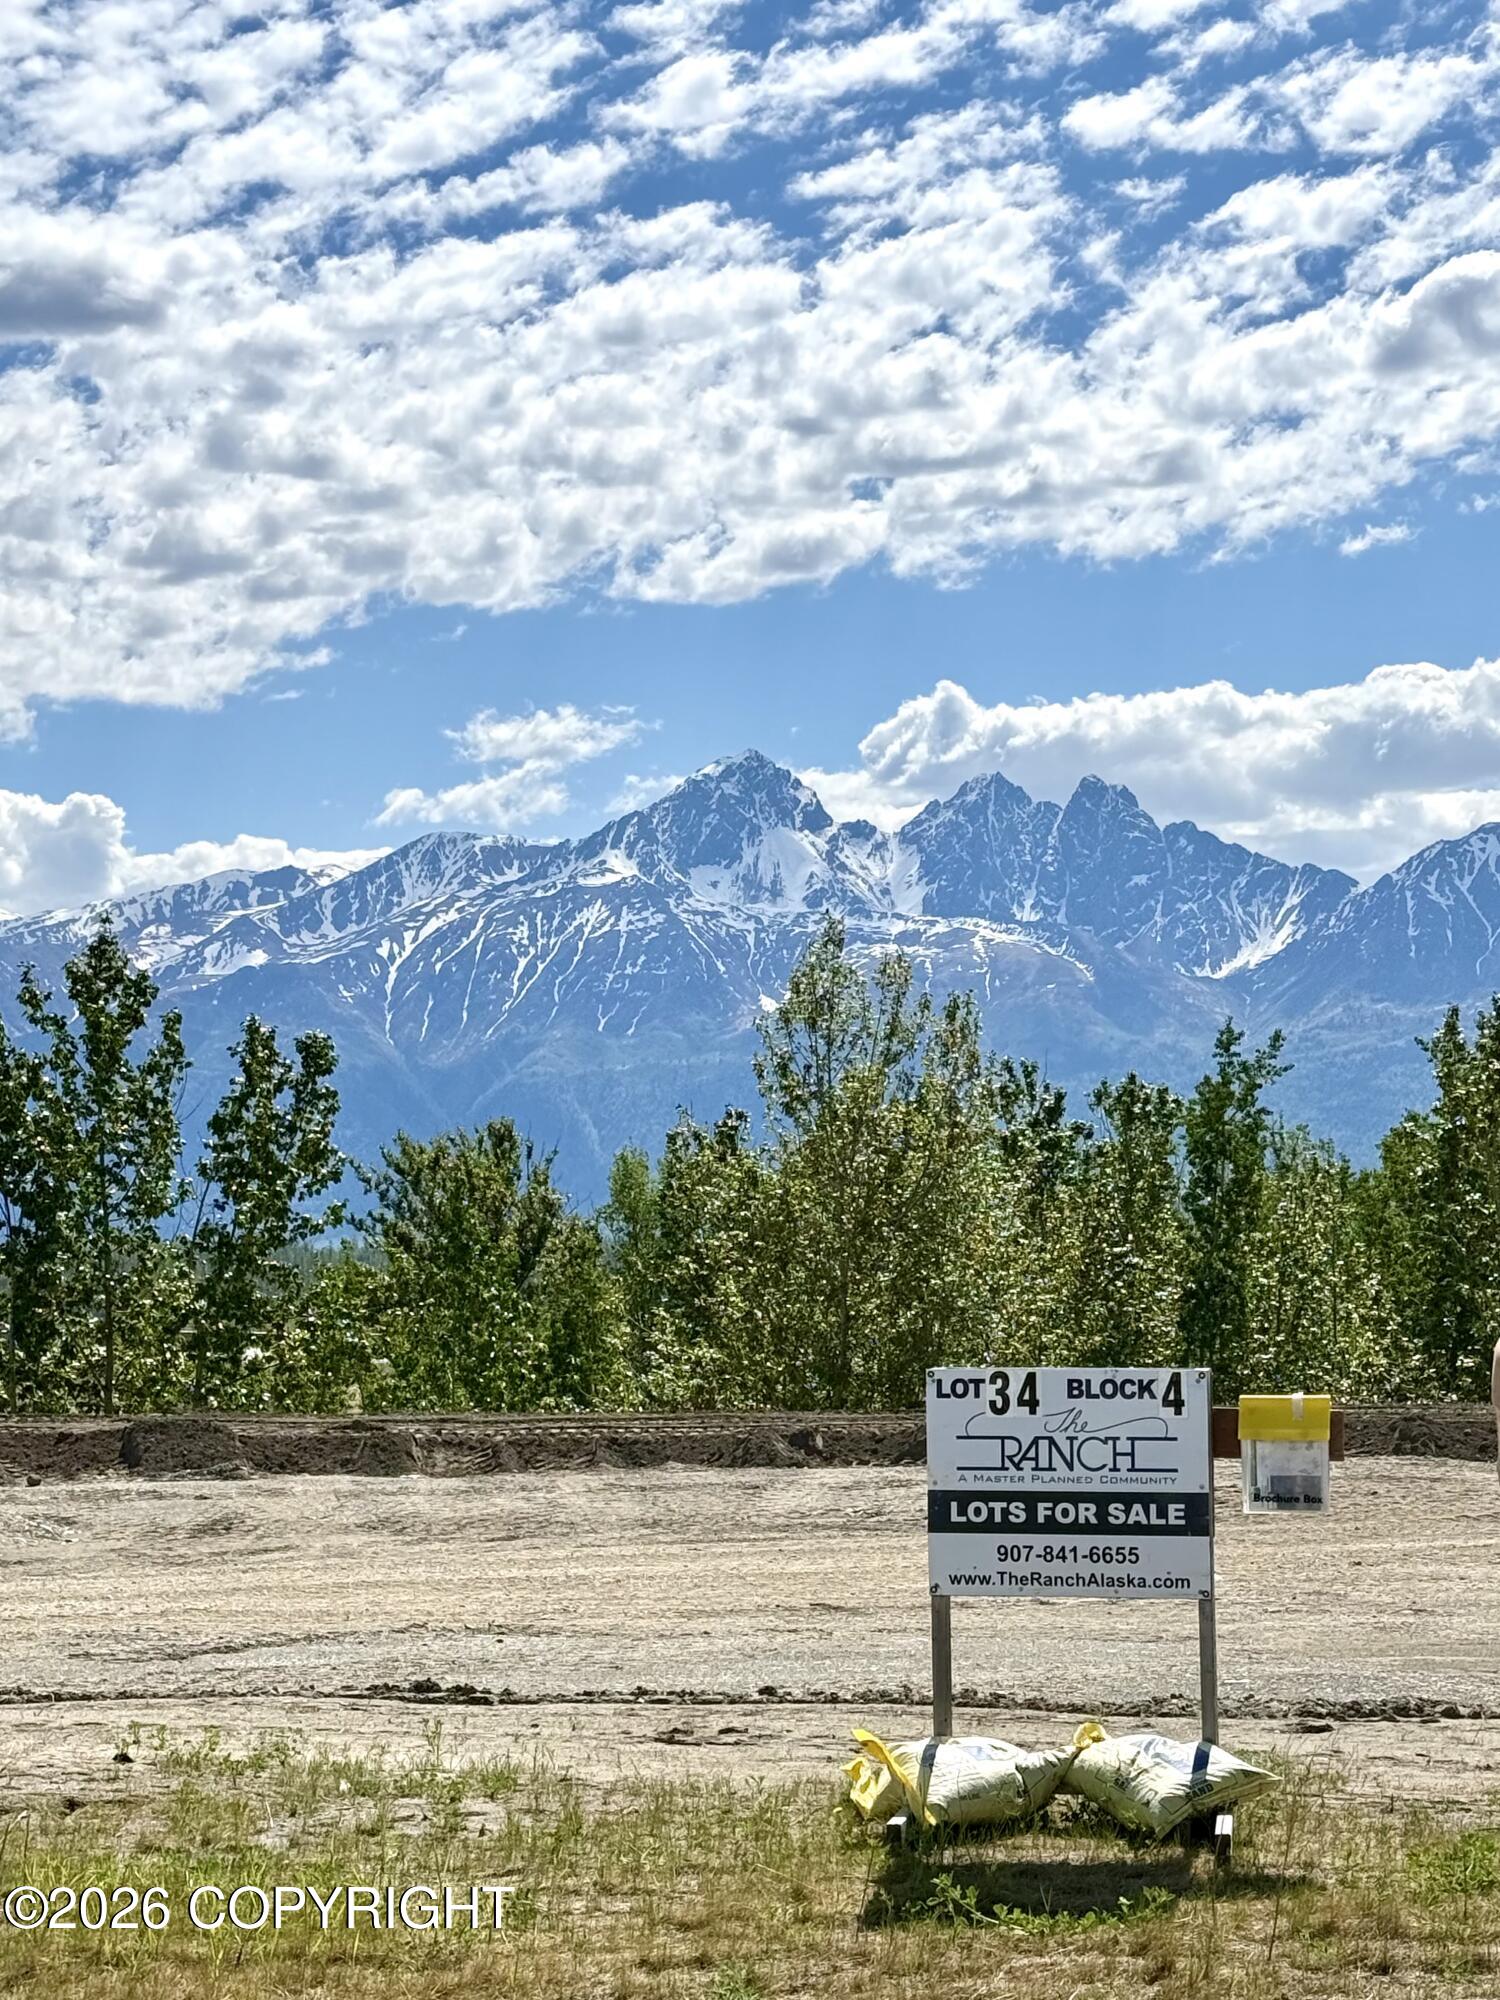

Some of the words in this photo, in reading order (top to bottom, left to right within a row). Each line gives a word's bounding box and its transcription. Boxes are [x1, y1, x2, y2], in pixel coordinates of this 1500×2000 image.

[936, 1379, 985, 1399] LOT
[988, 1371, 1040, 1416] 34
[1066, 1378, 1157, 1400] BLOCK
[1161, 1371, 1186, 1417] 4
[997, 1436, 1138, 1472] RANCH
[958, 1475, 968, 1484] A
[973, 1475, 1026, 1484] MASTER
[1031, 1475, 1094, 1485] PLANNED
[1099, 1475, 1179, 1486] COMMUNITY
[1253, 1493, 1300, 1504] Brochure
[1303, 1494, 1324, 1504] Box
[950, 1501, 1027, 1523] LOTS
[1037, 1503, 1098, 1524] FOR
[1107, 1503, 1187, 1526] SALE
[996, 1544, 1140, 1565] 907-841-6655
[948, 1570, 1191, 1590] www.TheRanchAlaska.com
